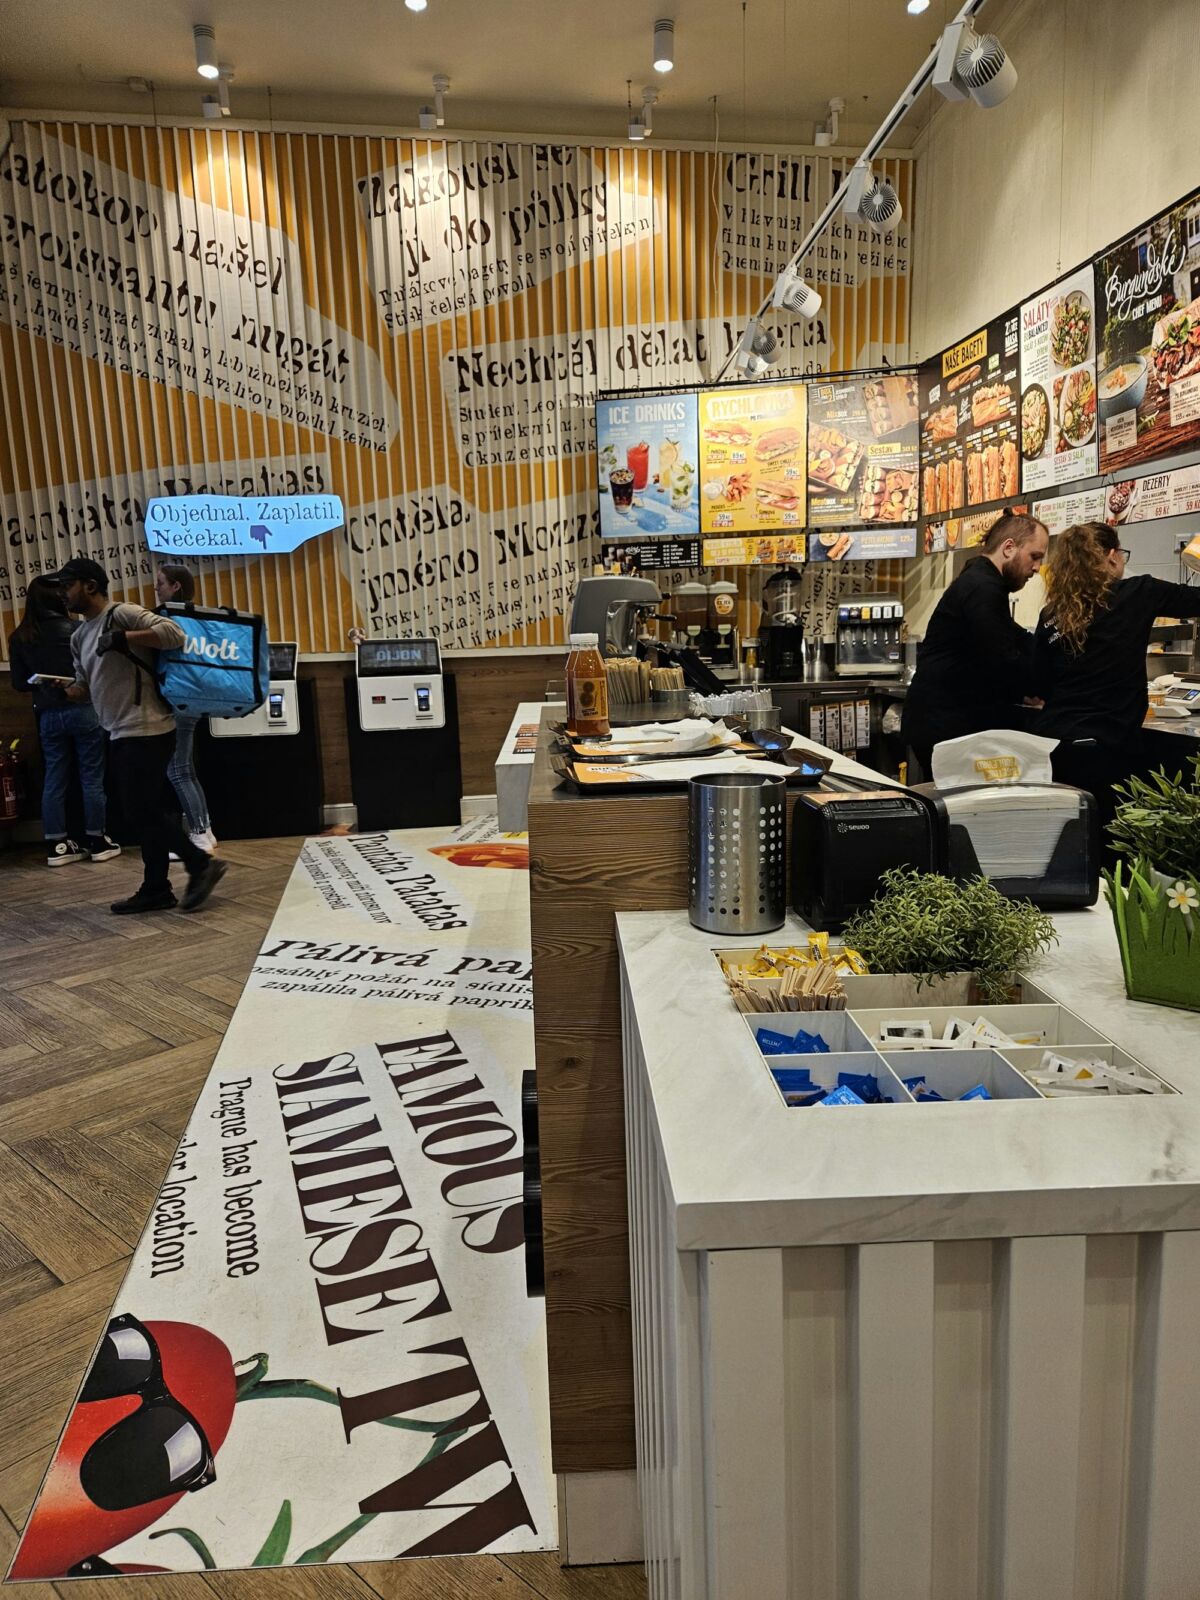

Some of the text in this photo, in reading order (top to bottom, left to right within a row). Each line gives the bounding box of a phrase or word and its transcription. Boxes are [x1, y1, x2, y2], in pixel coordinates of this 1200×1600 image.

[944, 336, 985, 372] NAŠE BAGETY
[609, 402, 685, 425] ICE DRINKS
[1142, 474, 1171, 491] DEZERTY
[150, 502, 341, 527] Objednal. Zaplatil.
[152, 528, 243, 547] Nečekal.
[182, 635, 240, 661] Wolt
[347, 834, 468, 931] Pantáta Patatas
[258, 940, 438, 968] Pálivá
[260, 980, 358, 996] zapálila
[361, 986, 441, 1002] pálivá
[341, 972, 418, 985] požár
[424, 978, 456, 988] na
[375, 1030, 526, 1254] FAMOUS
[210, 1077, 263, 1279] Prague has become
[272, 1052, 452, 1346] SIAMESE
[151, 1175, 198, 1279] location
